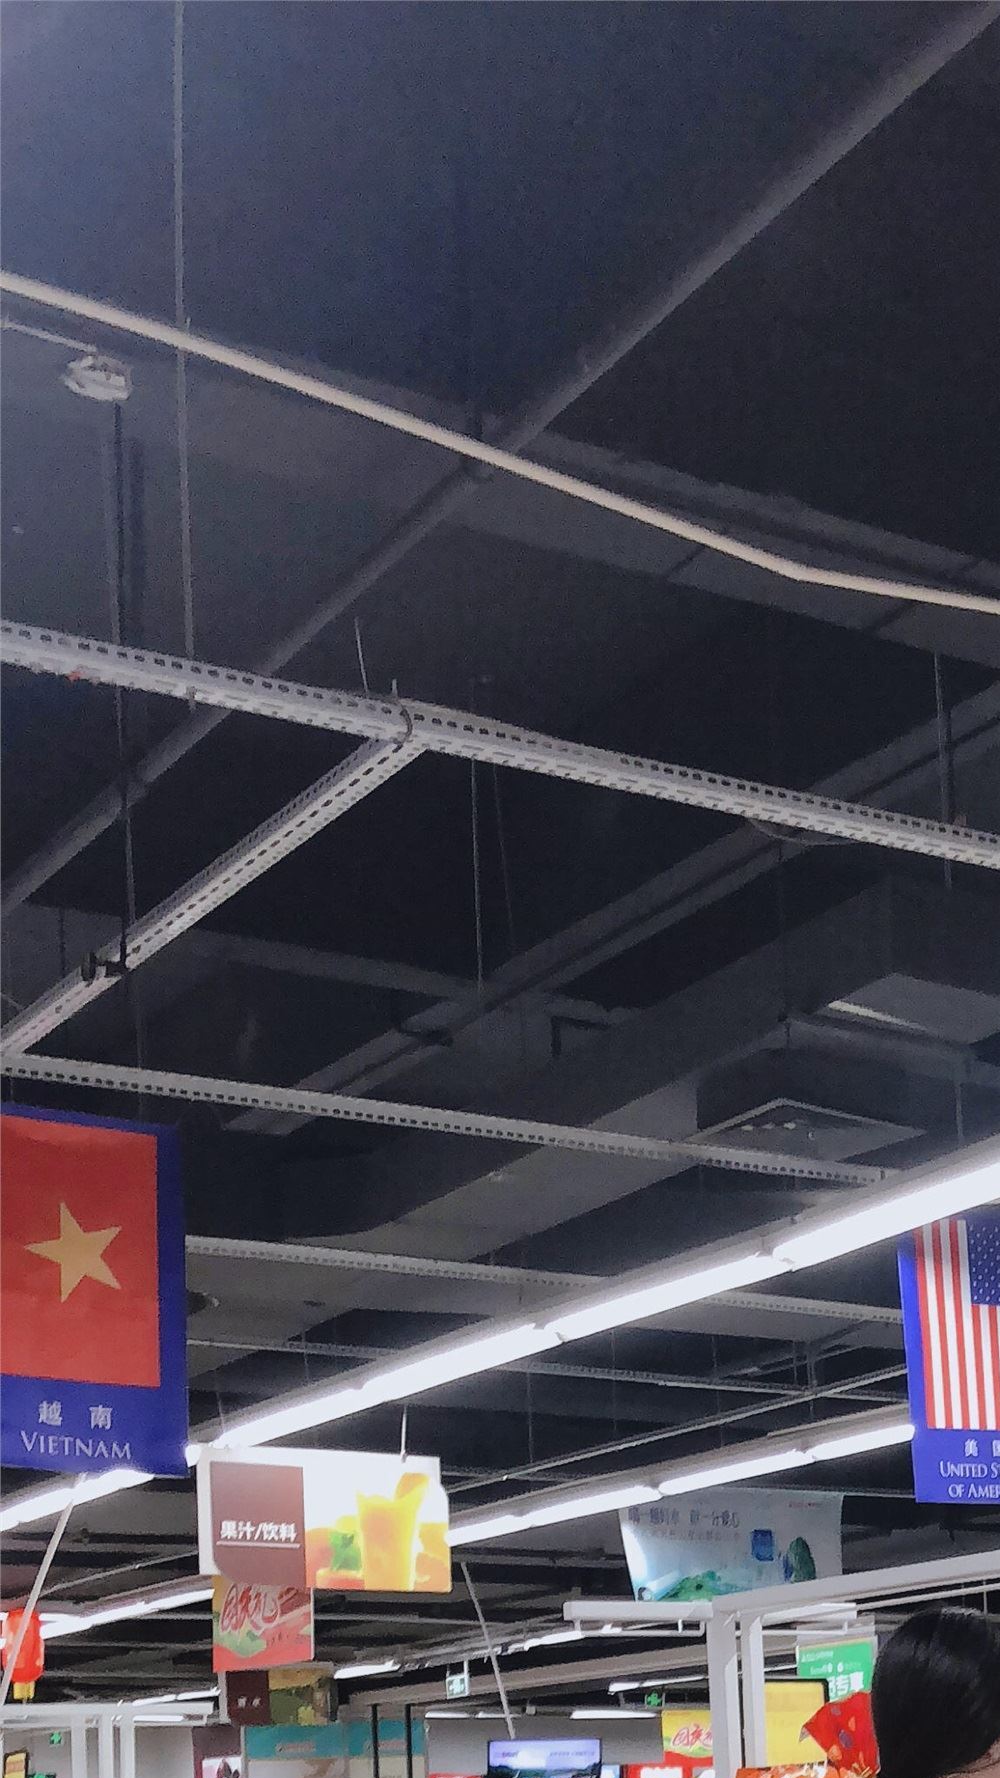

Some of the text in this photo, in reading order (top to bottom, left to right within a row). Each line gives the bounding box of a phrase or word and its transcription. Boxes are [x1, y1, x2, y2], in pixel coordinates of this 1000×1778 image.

[38, 1400, 113, 1430] 越南
[20, 1430, 131, 1460] VIETNAM
[939, 1460, 988, 1479] UNITED
[219, 1519, 298, 1543] 果汁/饮料
